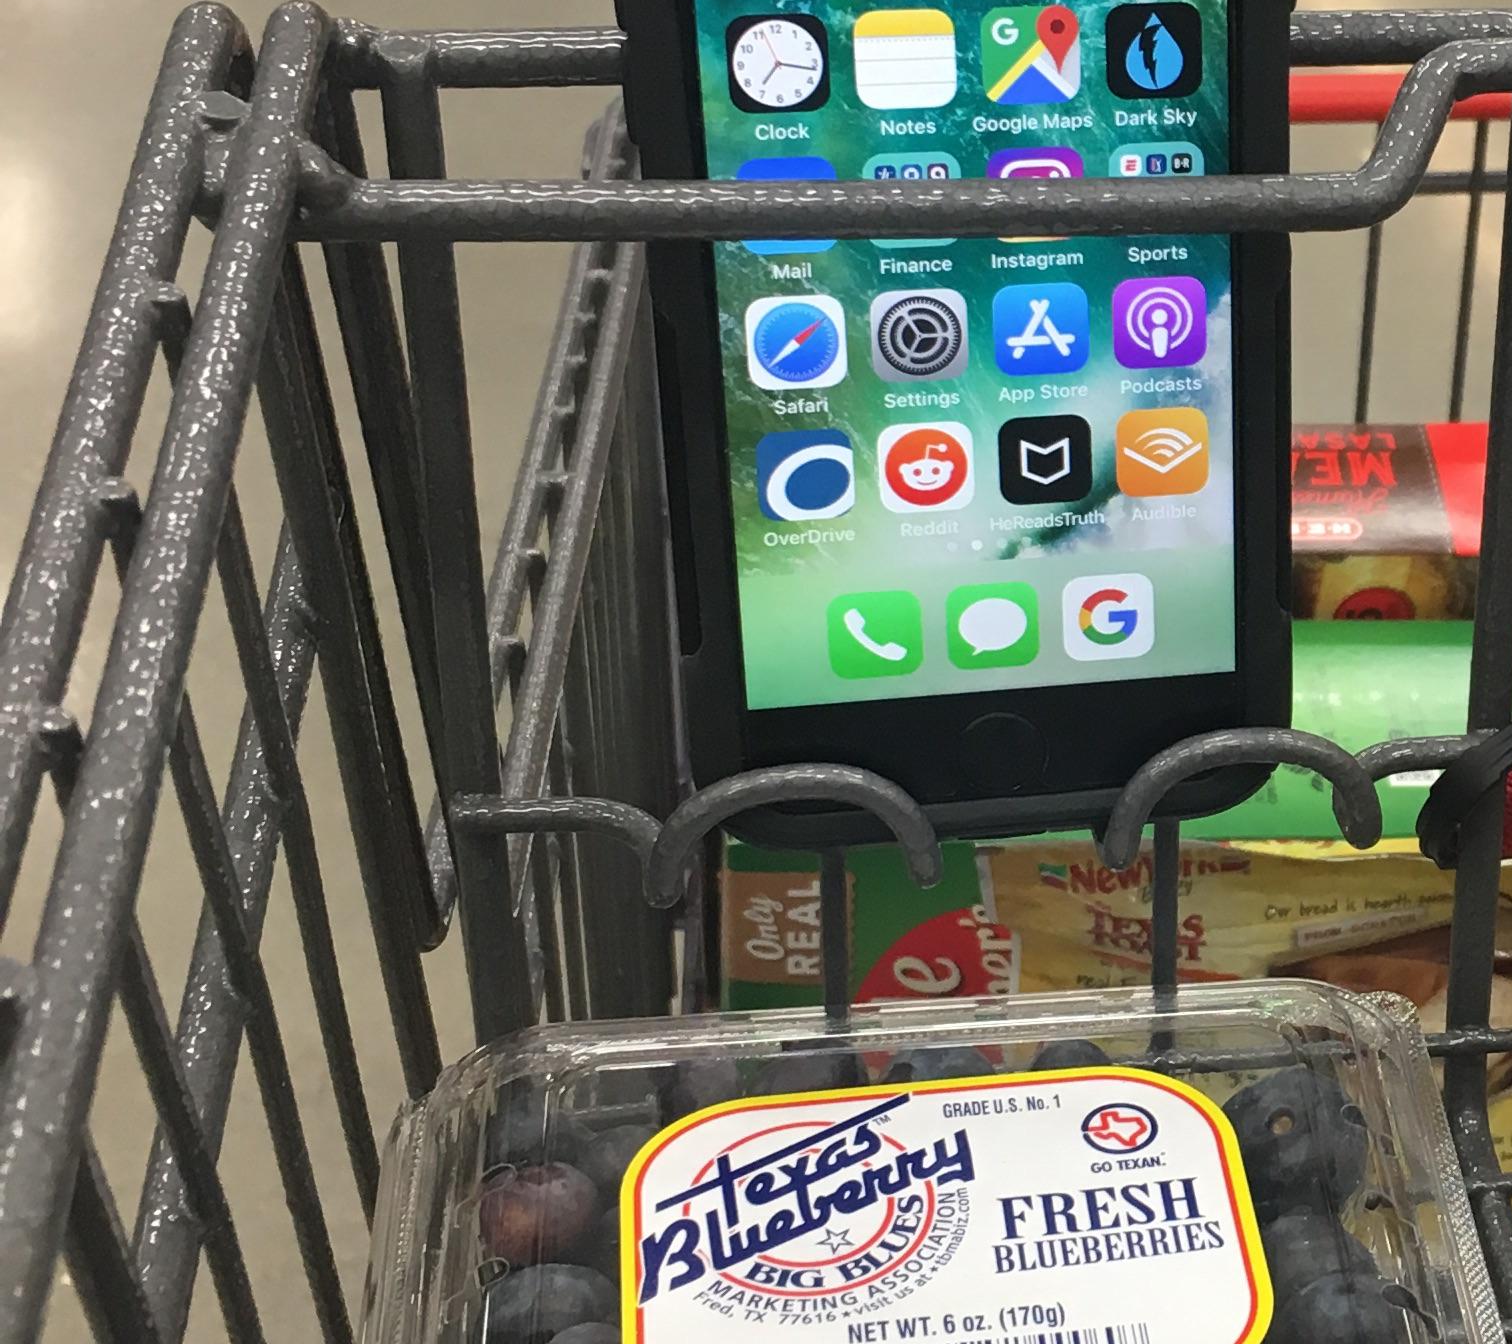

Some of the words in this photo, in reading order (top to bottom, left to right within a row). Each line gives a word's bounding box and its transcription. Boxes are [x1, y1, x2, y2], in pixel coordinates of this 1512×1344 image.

[752, 28, 765, 40] 11
[769, 24, 782, 34] 12
[792, 29, 798, 39] 1
[740, 44, 754, 54] 10
[804, 41, 812, 51] 2
[736, 60, 745, 71] 9
[811, 58, 819, 69] 3
[744, 78, 752, 88] 8
[806, 76, 815, 85] 4
[758, 89, 766, 99] 7
[776, 94, 784, 104] 6
[794, 88, 803, 98] 5
[880, 117, 937, 136] Notes
[972, 114, 1039, 135] Google
[1042, 111, 1094, 132] Maps
[1114, 110, 1157, 128] Dark
[1163, 108, 1198, 130] Sky
[754, 121, 810, 141] Clock
[990, 251, 1085, 272] Instagram
[1127, 244, 1189, 266] Sports
[772, 262, 813, 280] Mail
[878, 257, 953, 275] Finance
[998, 385, 1035, 405] App
[1039, 381, 1090, 400] Store
[1119, 375, 1203, 395] Podcasts
[773, 397, 830, 416] Safari
[883, 390, 961, 411] Settings
[1291, 432, 1397, 450] LASA
[989, 509, 1106, 532] HeReadsTruth
[1131, 502, 1198, 522] Audible
[763, 528, 857, 548] OverDrive
[899, 519, 960, 538] Reddit
[742, 892, 785, 961] Only
[786, 879, 822, 976] REAL
[942, 1098, 991, 1119] GRADE
[992, 1097, 1024, 1115] U.S.
[1026, 1096, 1050, 1111] No.
[1053, 1094, 1062, 1109] 1
[1090, 1160, 1113, 1174] GO
[639, 1128, 976, 1306] Blueberry
[996, 1176, 1206, 1241] FRESH
[743, 1260, 827, 1289] BIG
[839, 1192, 925, 1284] BLUES
[991, 1220, 1226, 1274] BLUEBERRIES
[706, 1279, 859, 1314] MARKETING
[867, 1190, 957, 1301] ASSOCIATION
[692, 1290, 734, 1320] Fred,
[742, 1309, 766, 1324] TX
[778, 1310, 837, 1326] 77616
[847, 1320, 892, 1344] NET
[896, 1316, 938, 1340] WT.
[942, 1314, 957, 1335] 6
[962, 1315, 993, 1332] oz.
[998, 1301, 1067, 1333] (170g)
